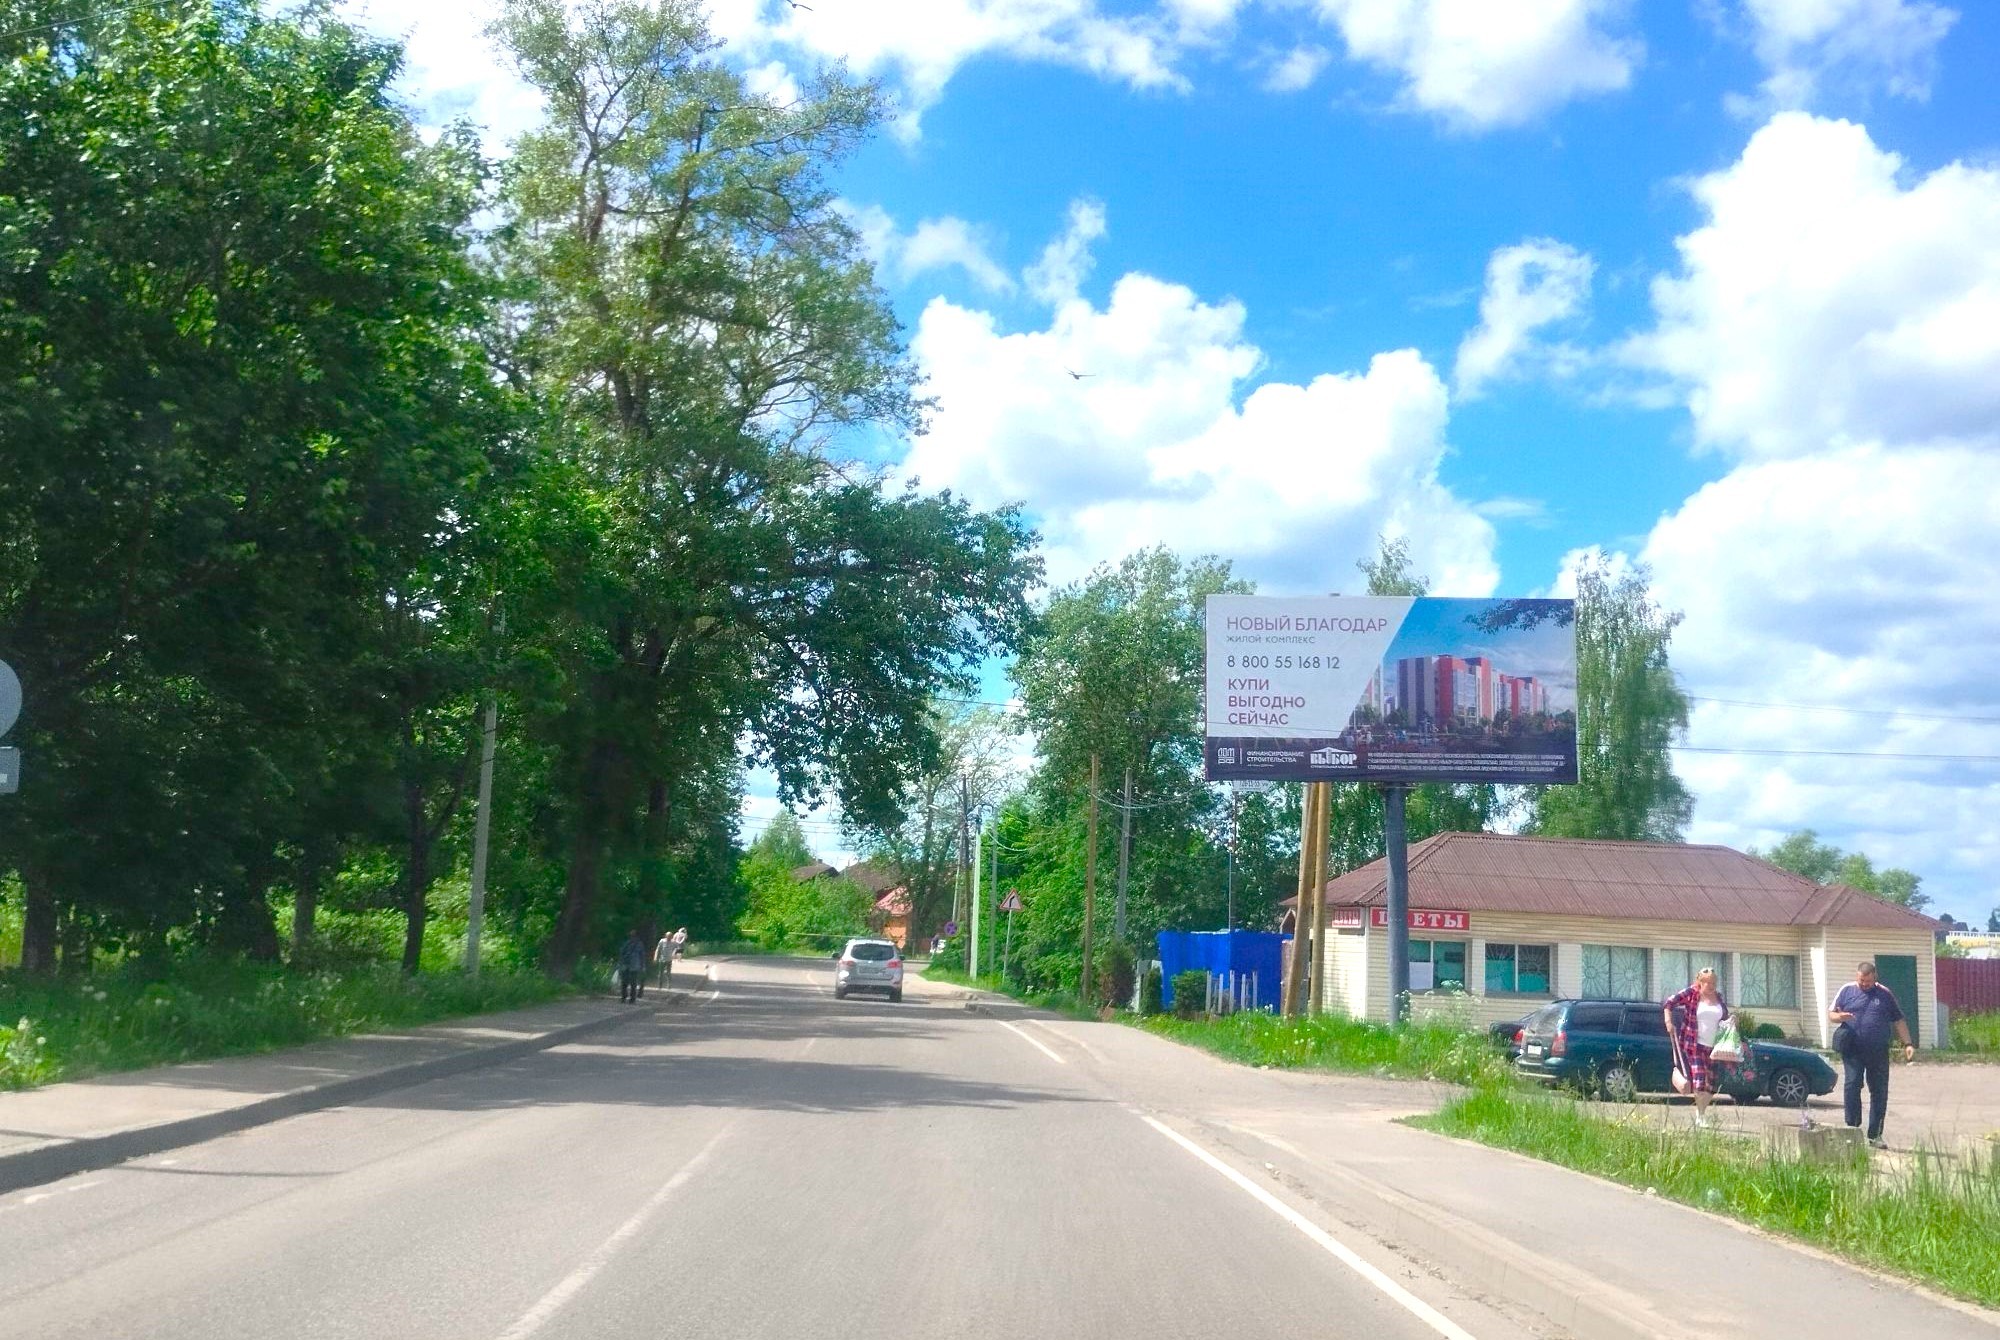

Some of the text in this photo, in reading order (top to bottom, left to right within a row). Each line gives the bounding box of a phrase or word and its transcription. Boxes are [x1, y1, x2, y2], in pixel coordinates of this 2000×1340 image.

[1227, 615, 1388, 634] НОВЫЙ БЛАГОДАР
[1227, 634, 1316, 644] ЖИЛОЙ КОМПЛЕКС
[1228, 655, 1340, 669] 8 800 55 168 12
[1228, 678, 1270, 691] КУПИ
[1228, 696, 1306, 710] ВЫГОДНО
[1228, 710, 1289, 725] СЕЙЧАС
[1310, 752, 1358, 765] ВЫБОР
